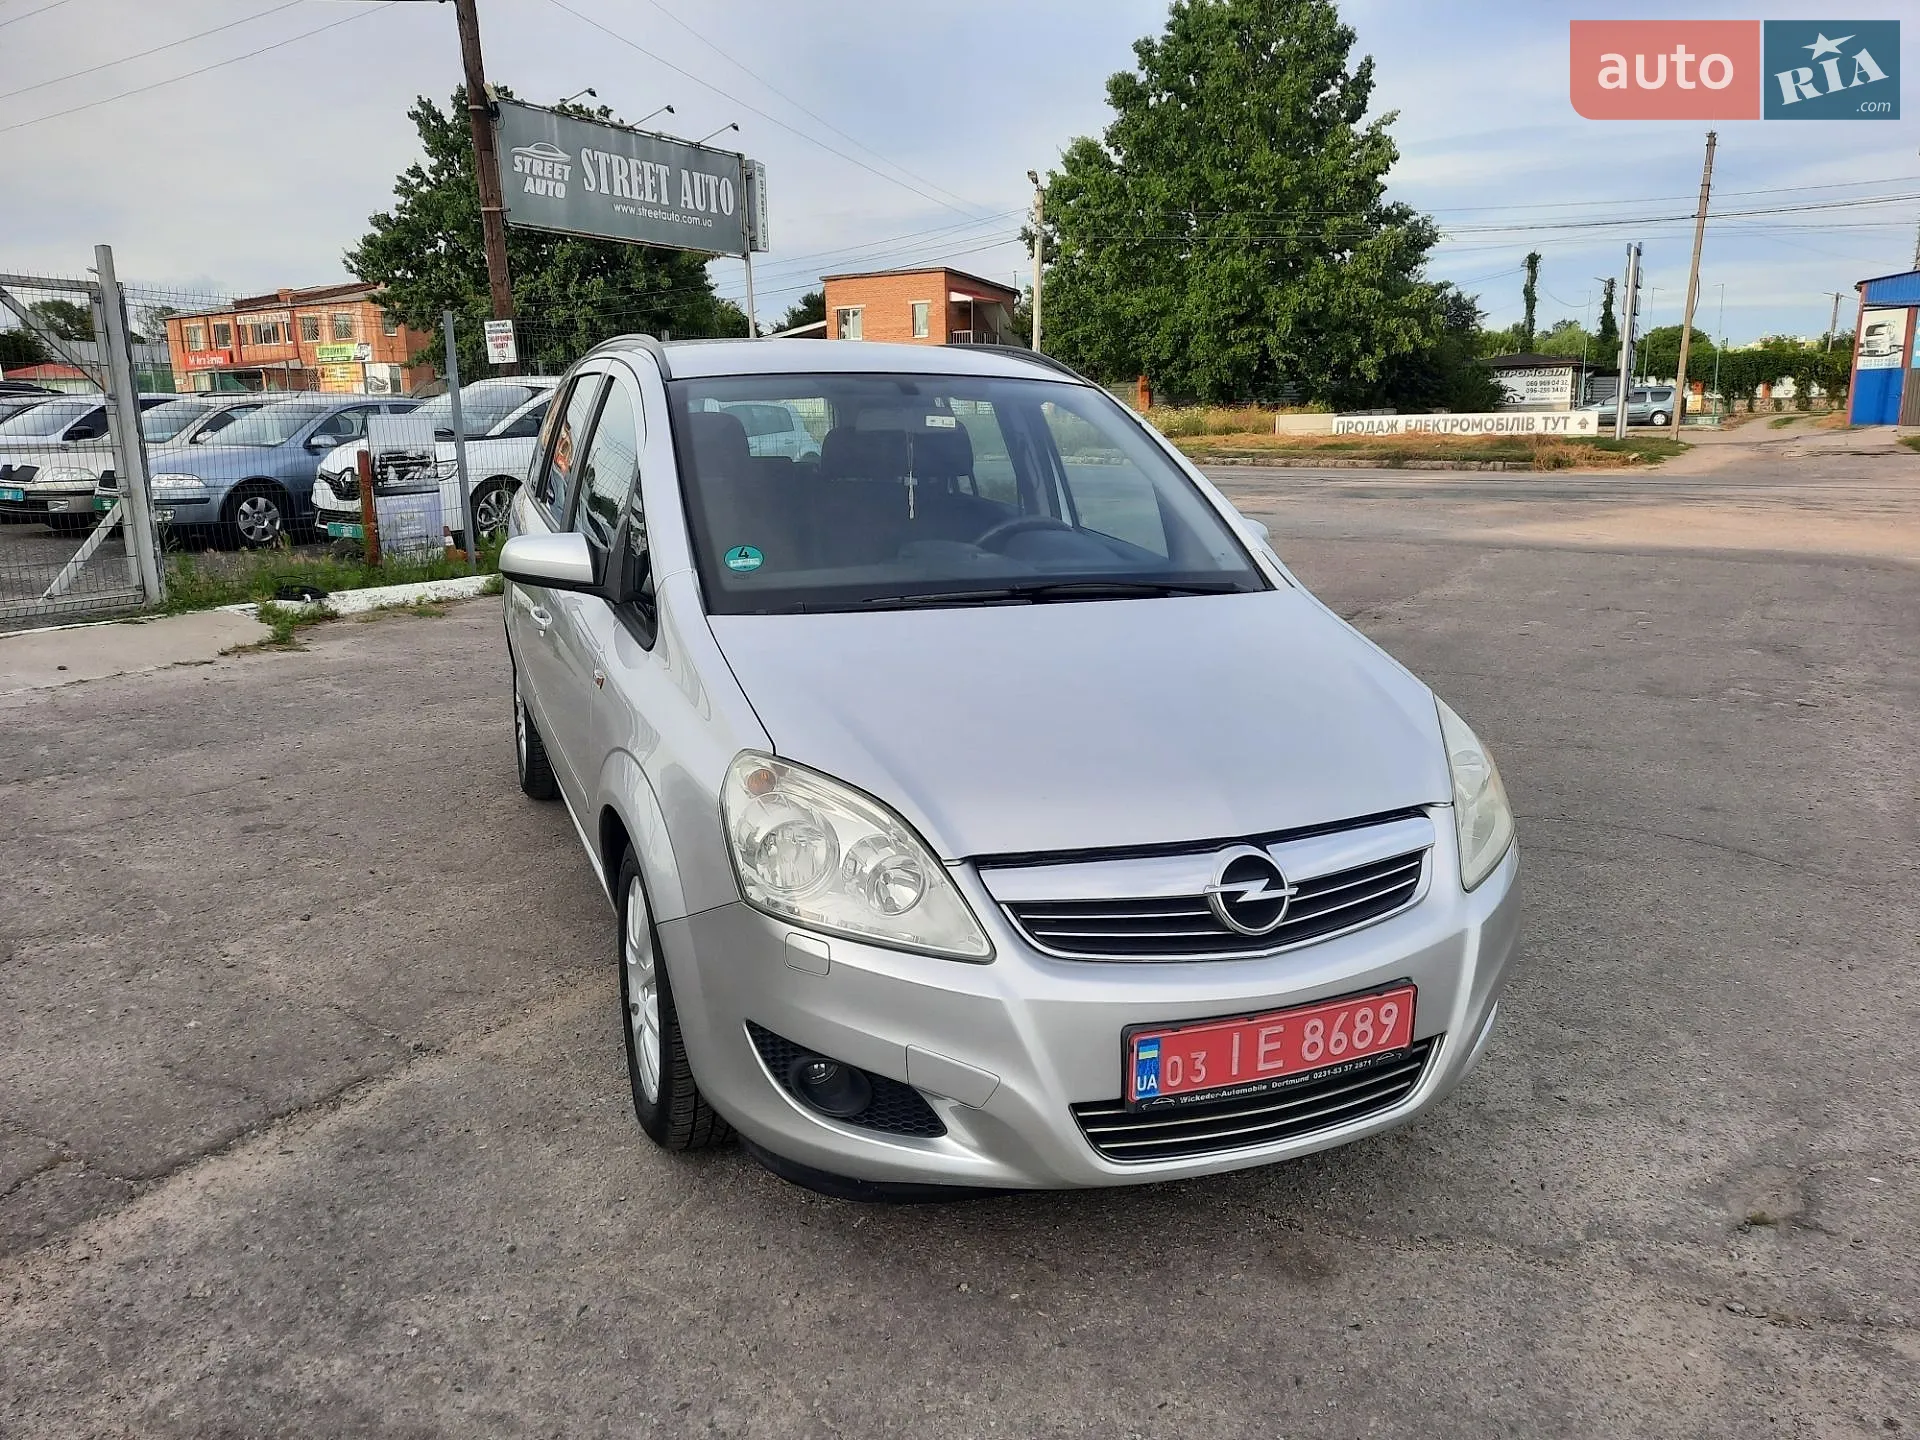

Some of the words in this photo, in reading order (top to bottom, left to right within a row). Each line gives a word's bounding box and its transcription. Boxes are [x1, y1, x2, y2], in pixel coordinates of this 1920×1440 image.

[513, 155, 572, 182] STREET
[580, 147, 670, 205] STREET
[680, 168, 735, 216] AUTO
[524, 177, 567, 199] AUTO
[613, 202, 713, 228] www.streetauto.com.ua
[1336, 419, 1399, 435] ПРОДАЖ
[1404, 416, 1535, 433] ЕЛЕКТРОМОБІЛІВ
[1542, 416, 1571, 431] ТУТ
[737, 546, 749, 559] 4
[1165, 1051, 1208, 1087] 03
[1231, 1024, 1285, 1076] IE
[1301, 1002, 1399, 1062] 8689
[1137, 1075, 1158, 1092] UA
[1180, 1083, 1268, 1104] Wickeder-Automobile
[1271, 1075, 1310, 1090] Dortmund
